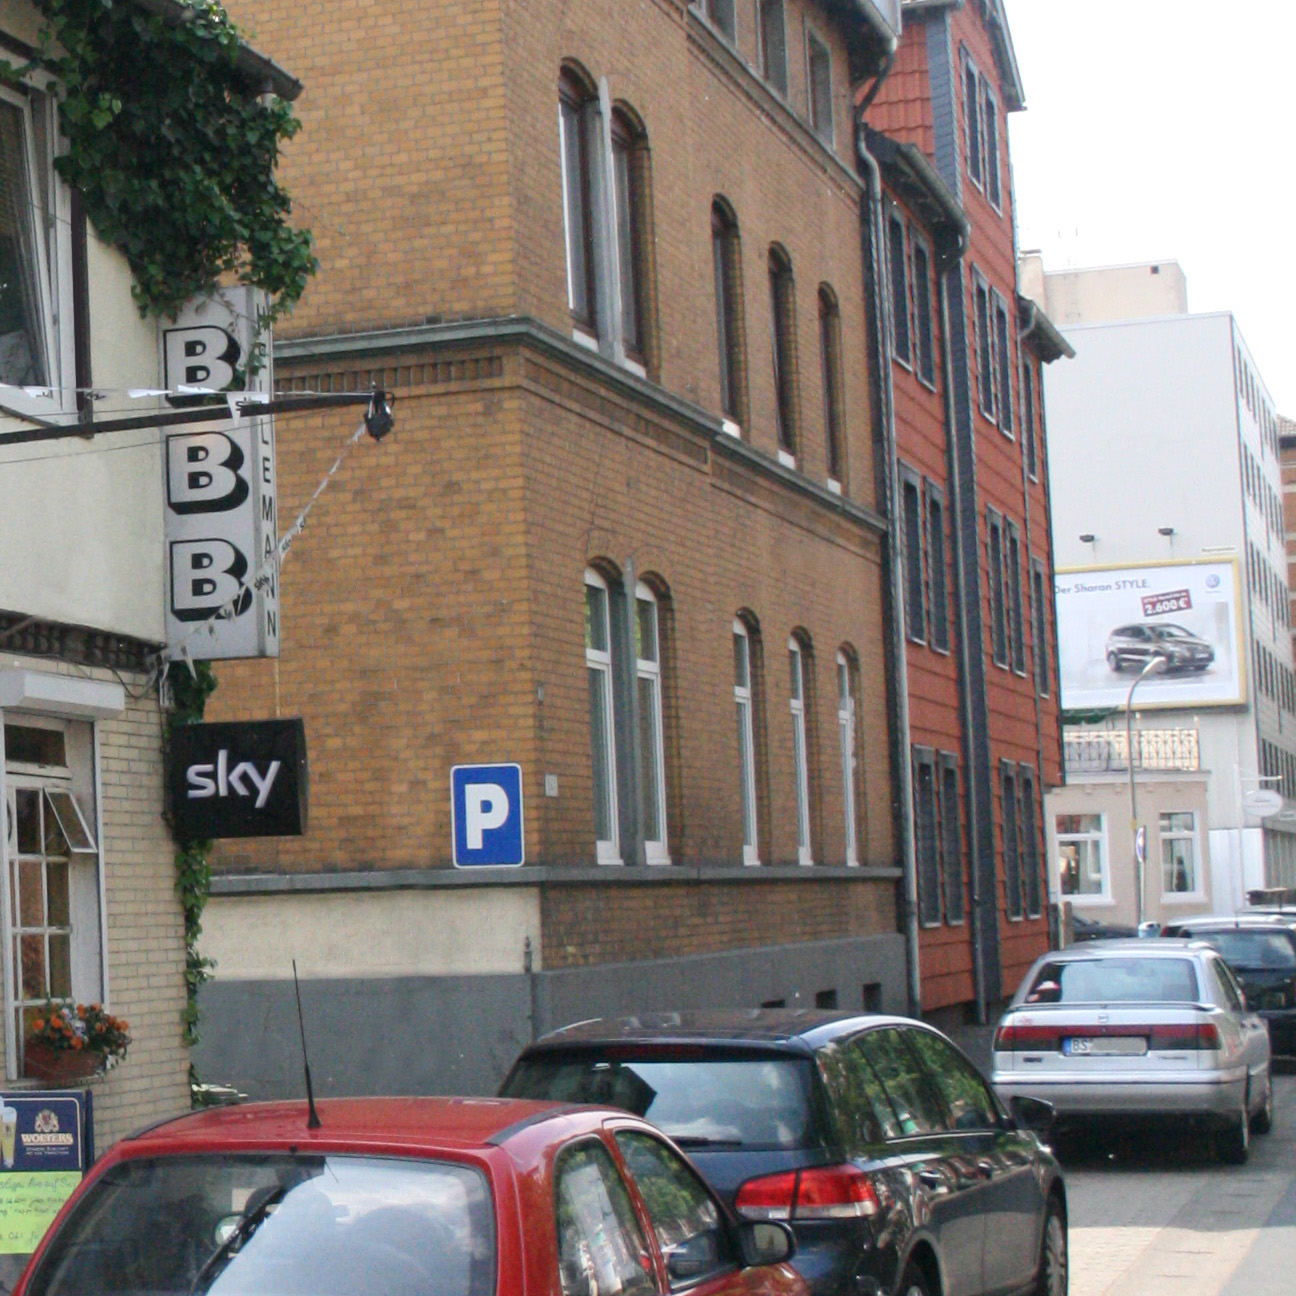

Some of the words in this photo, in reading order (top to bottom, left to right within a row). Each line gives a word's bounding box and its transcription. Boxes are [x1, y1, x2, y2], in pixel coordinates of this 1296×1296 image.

[1074, 583, 1112, 593] Sharan
[186, 749, 281, 808] sky
[464, 783, 509, 850] P
[1073, 1039, 1088, 1051] BS
[21, 1133, 73, 1145] WOLTERS
